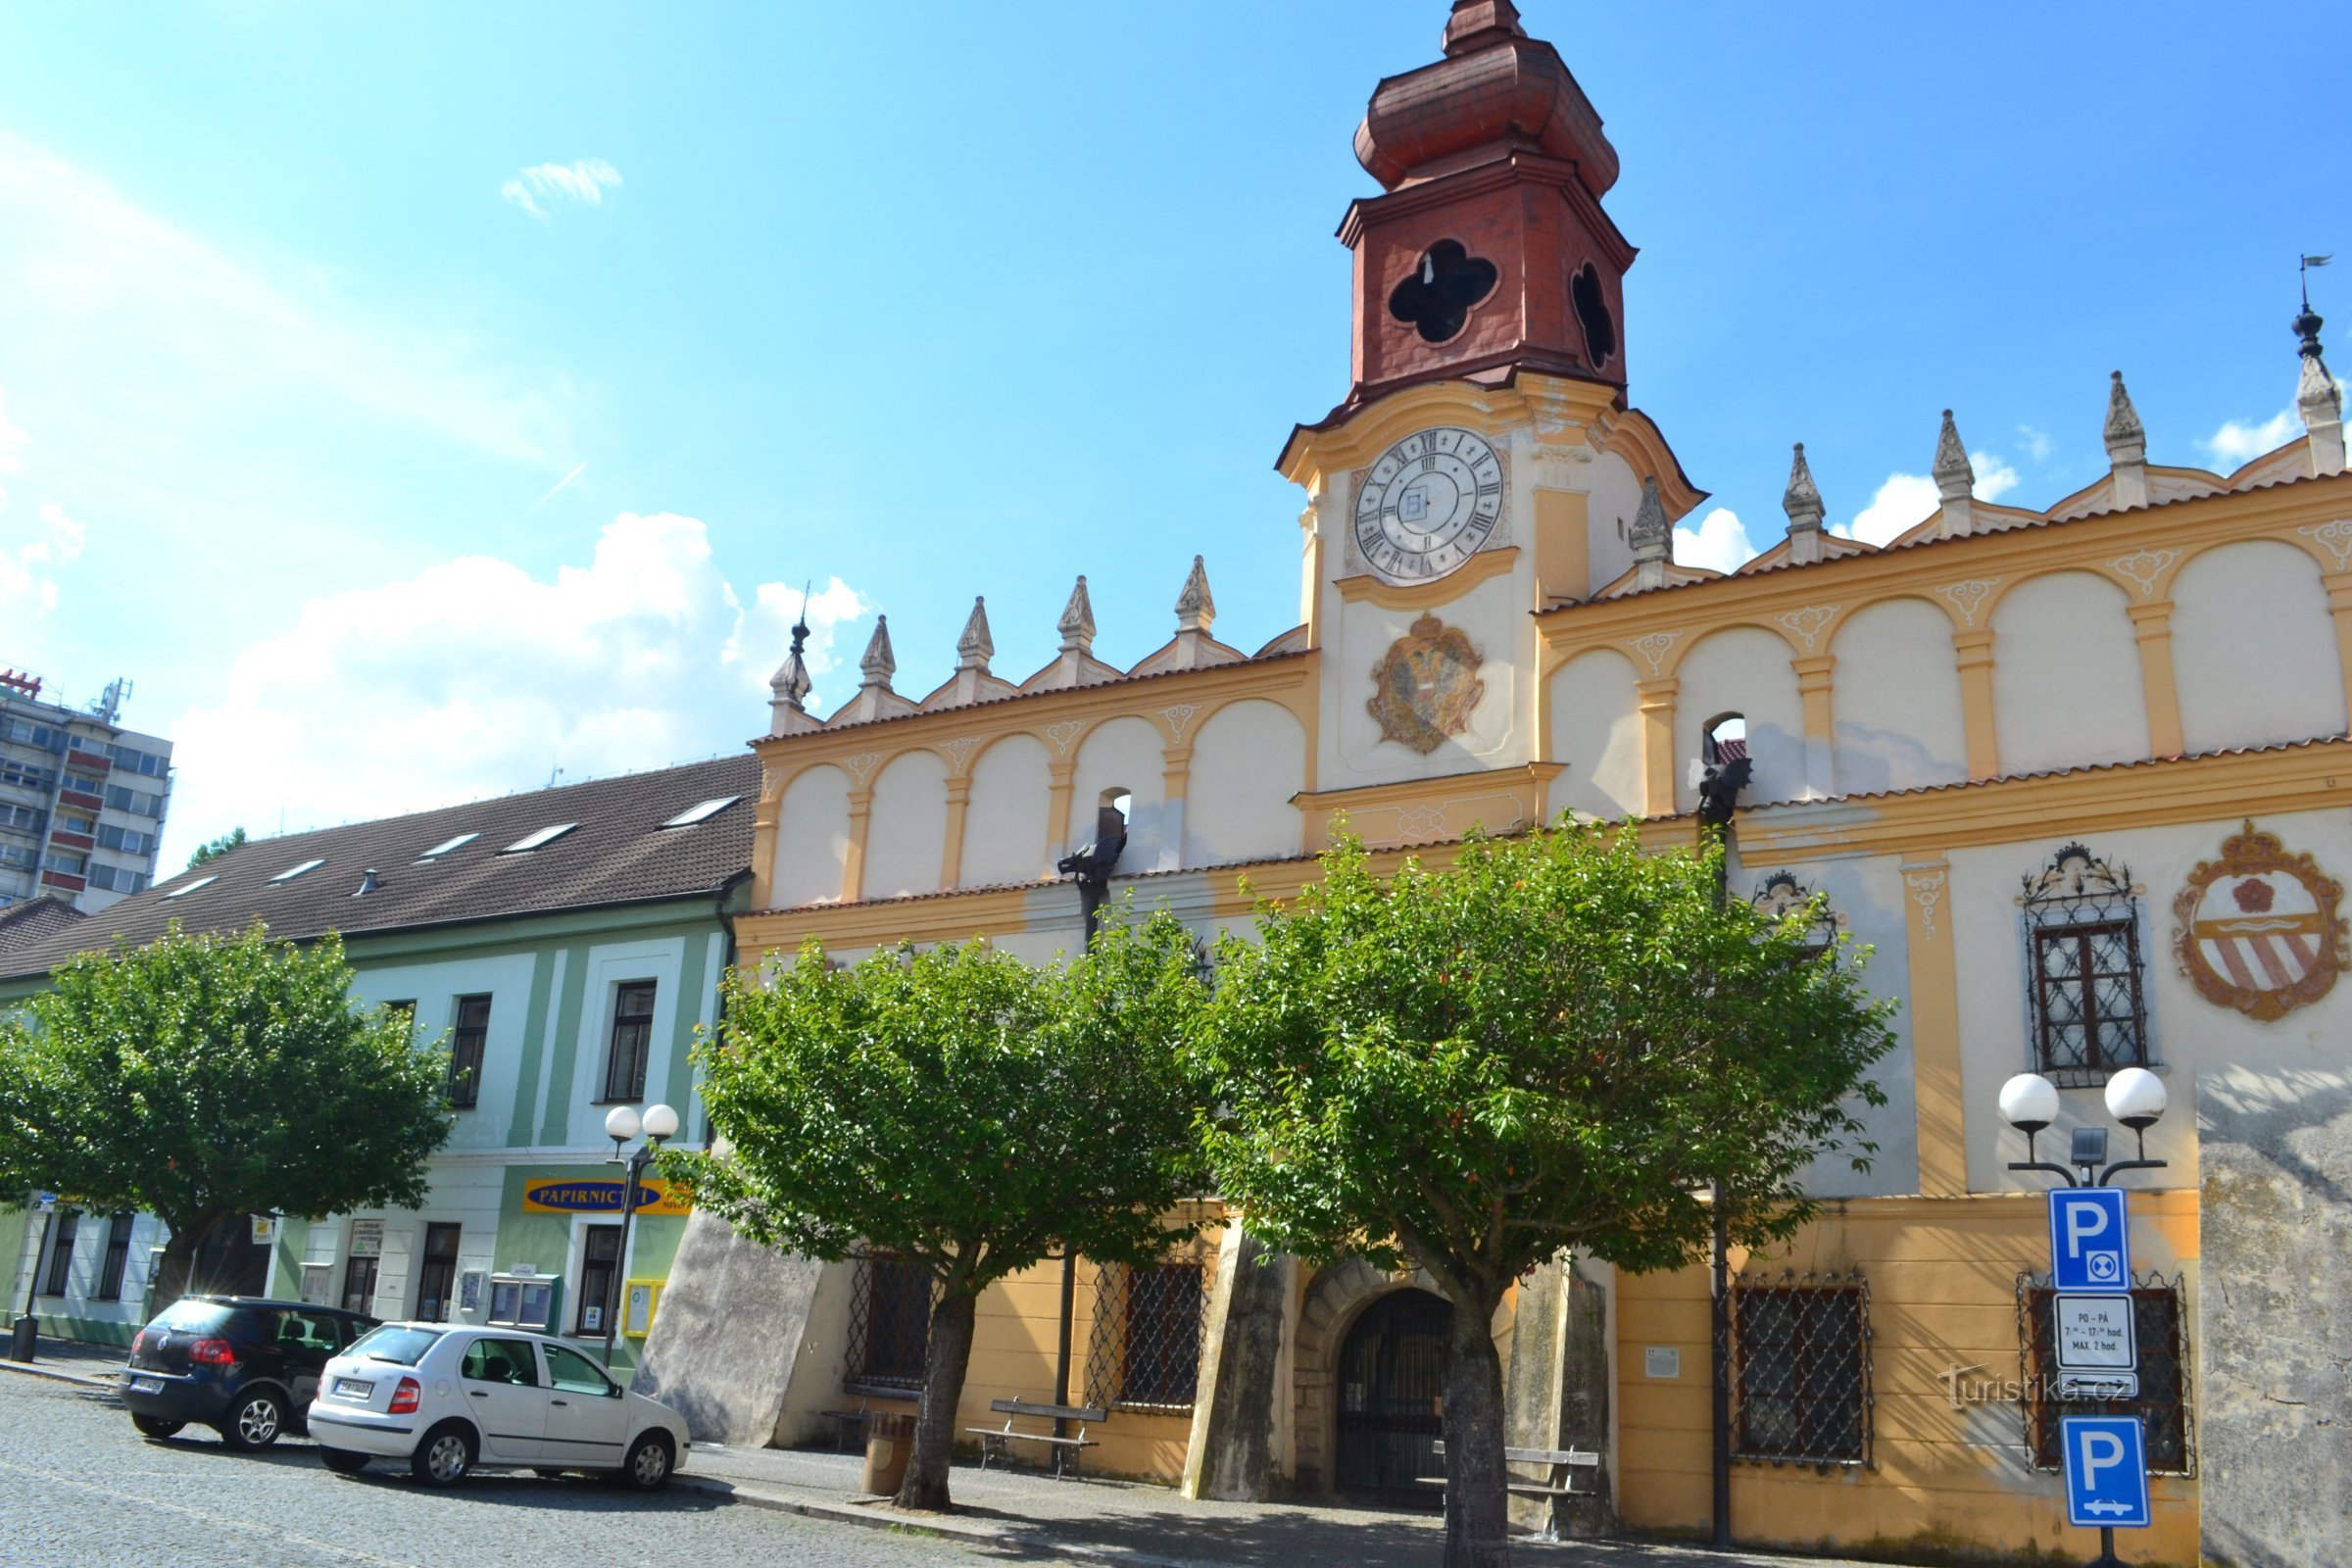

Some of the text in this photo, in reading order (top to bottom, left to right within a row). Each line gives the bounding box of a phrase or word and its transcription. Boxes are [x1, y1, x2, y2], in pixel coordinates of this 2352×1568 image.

[539, 1188, 648, 1203] PAPIRNICTÍ
[2066, 1201, 2108, 1258] P
[2079, 1313, 2088, 1323] PO
[2098, 1311, 2108, 1323] PÁ
[2094, 1342, 2099, 1350] 2
[2081, 1431, 2125, 1491] P
